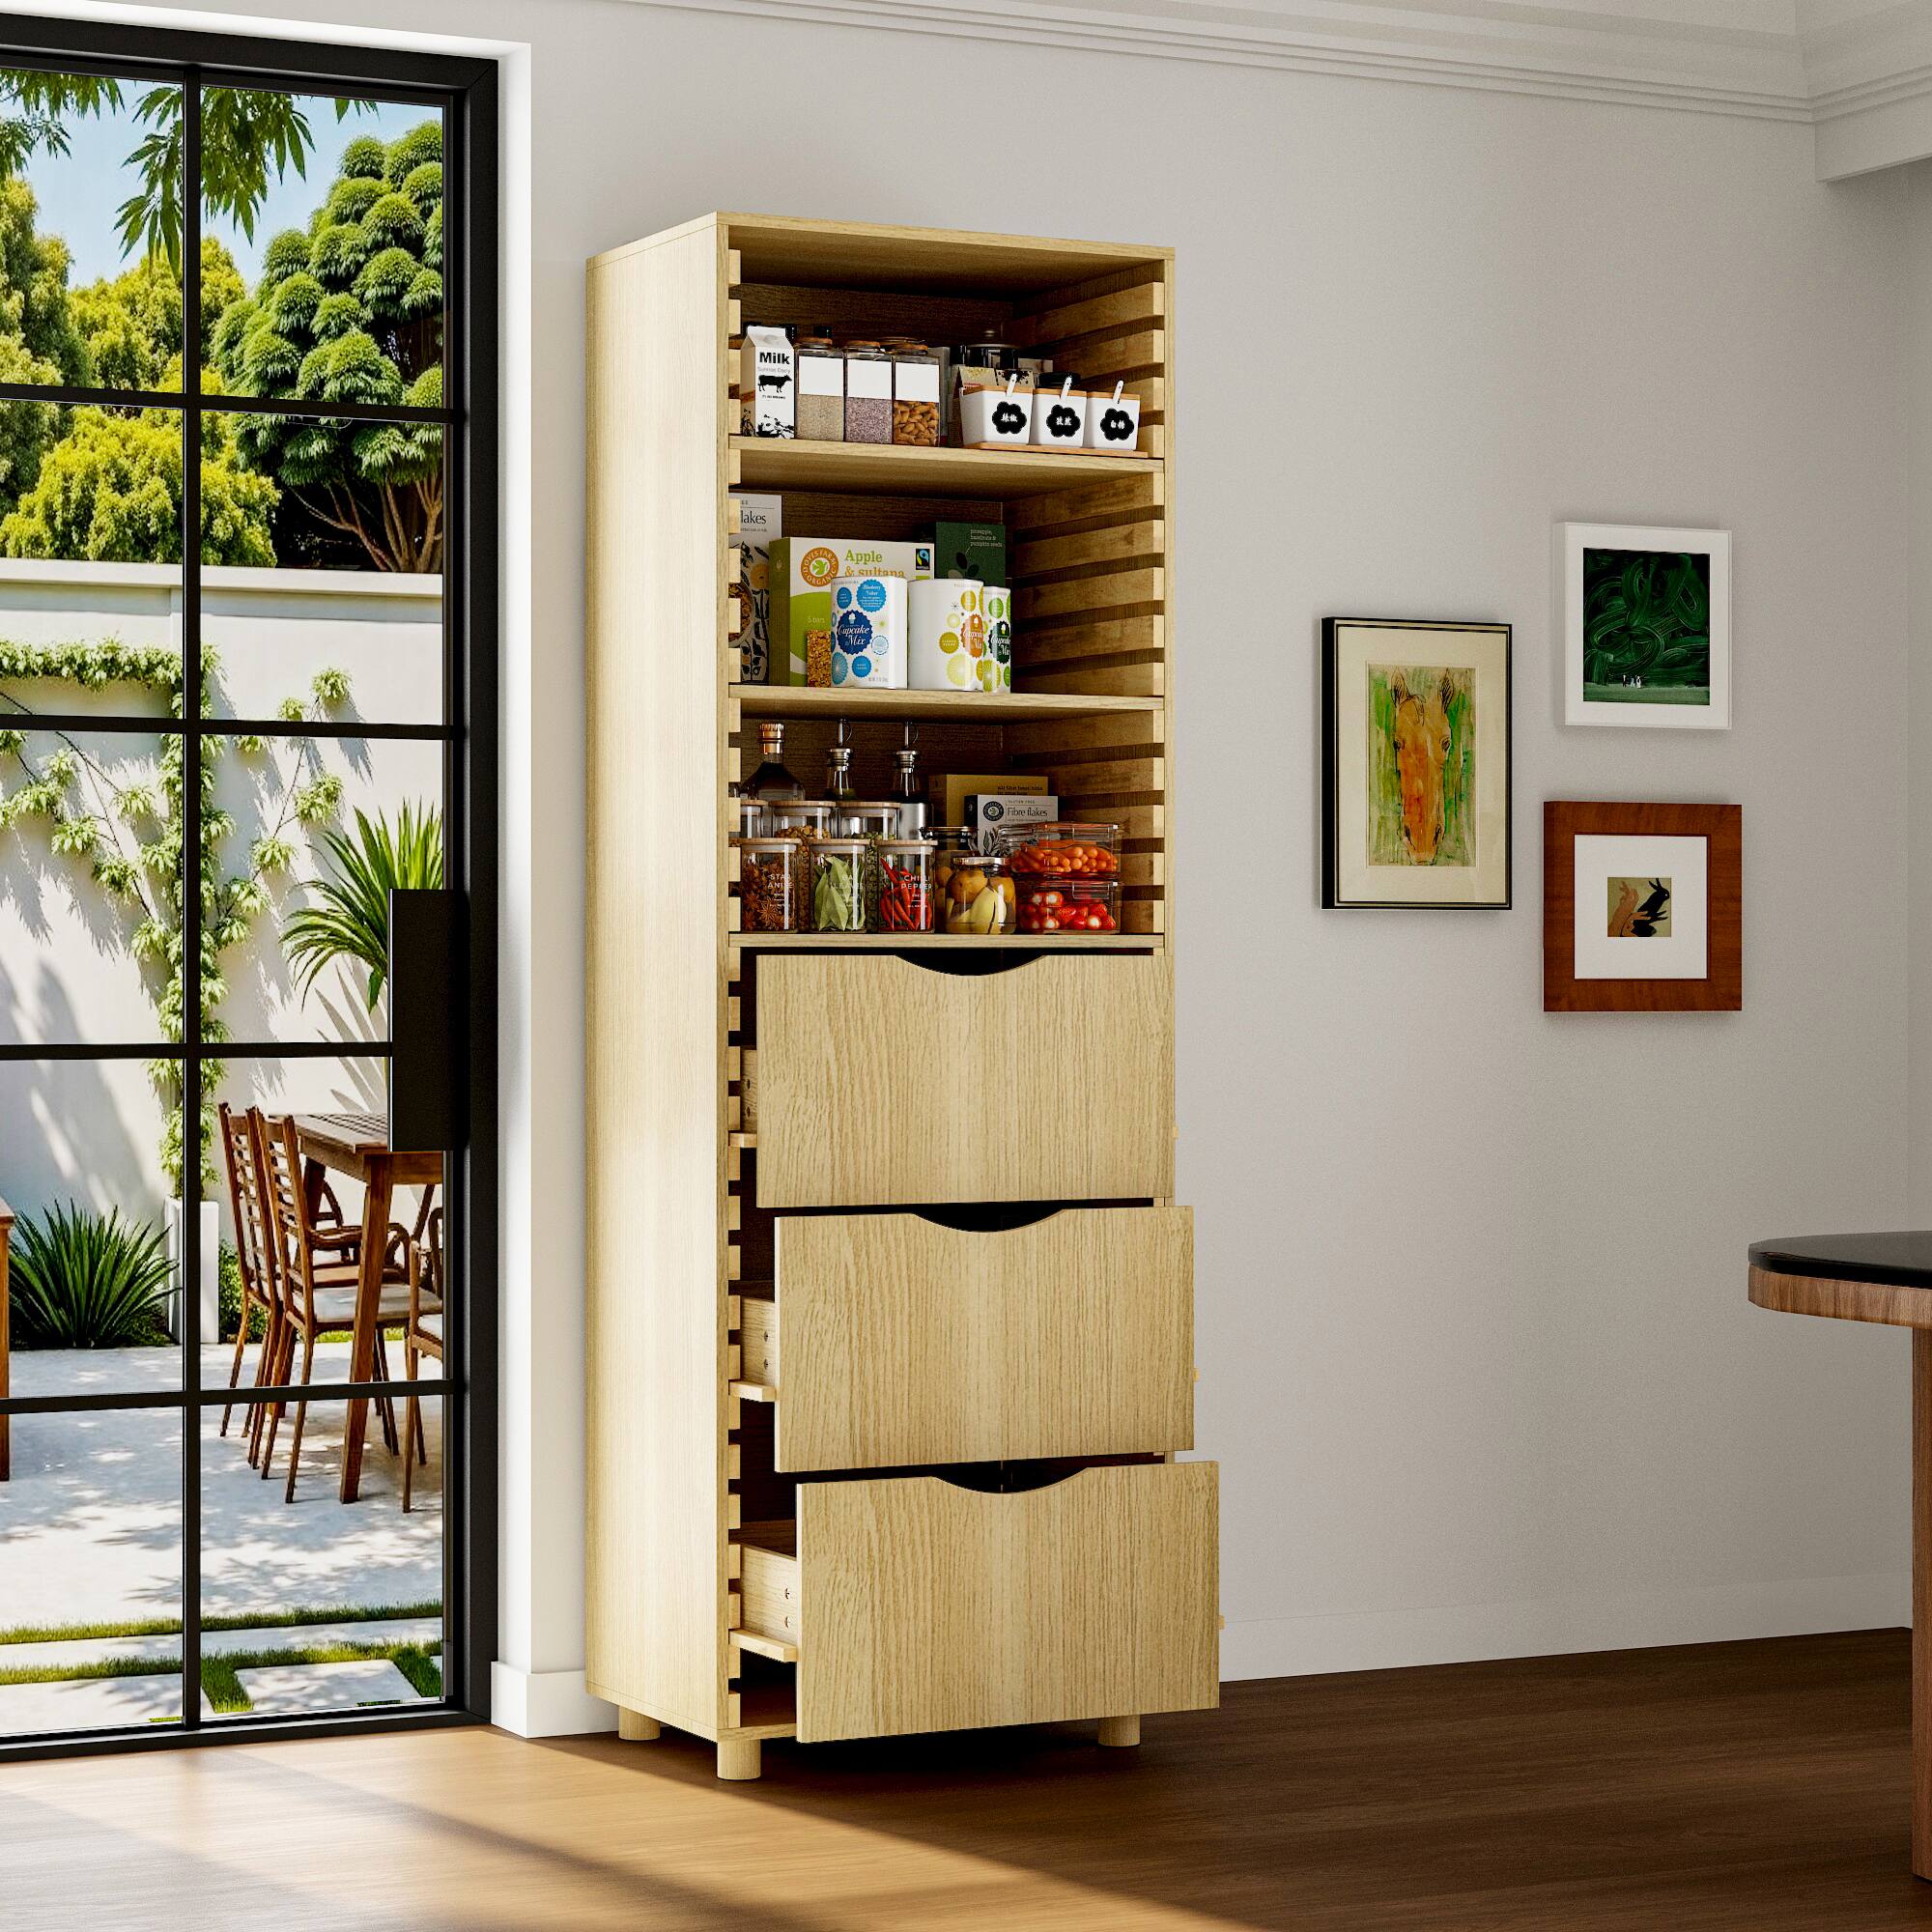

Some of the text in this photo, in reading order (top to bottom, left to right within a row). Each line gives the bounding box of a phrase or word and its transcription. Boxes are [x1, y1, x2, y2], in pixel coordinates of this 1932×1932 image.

[759, 352, 790, 364] Milk
[740, 510, 766, 525] lakes
[844, 550, 883, 564] Apple
[844, 565, 855, 577] &
[838, 624, 870, 638] Cupcake
[848, 635, 867, 646] Mix
[1007, 807, 1048, 817] Fibre flakes
